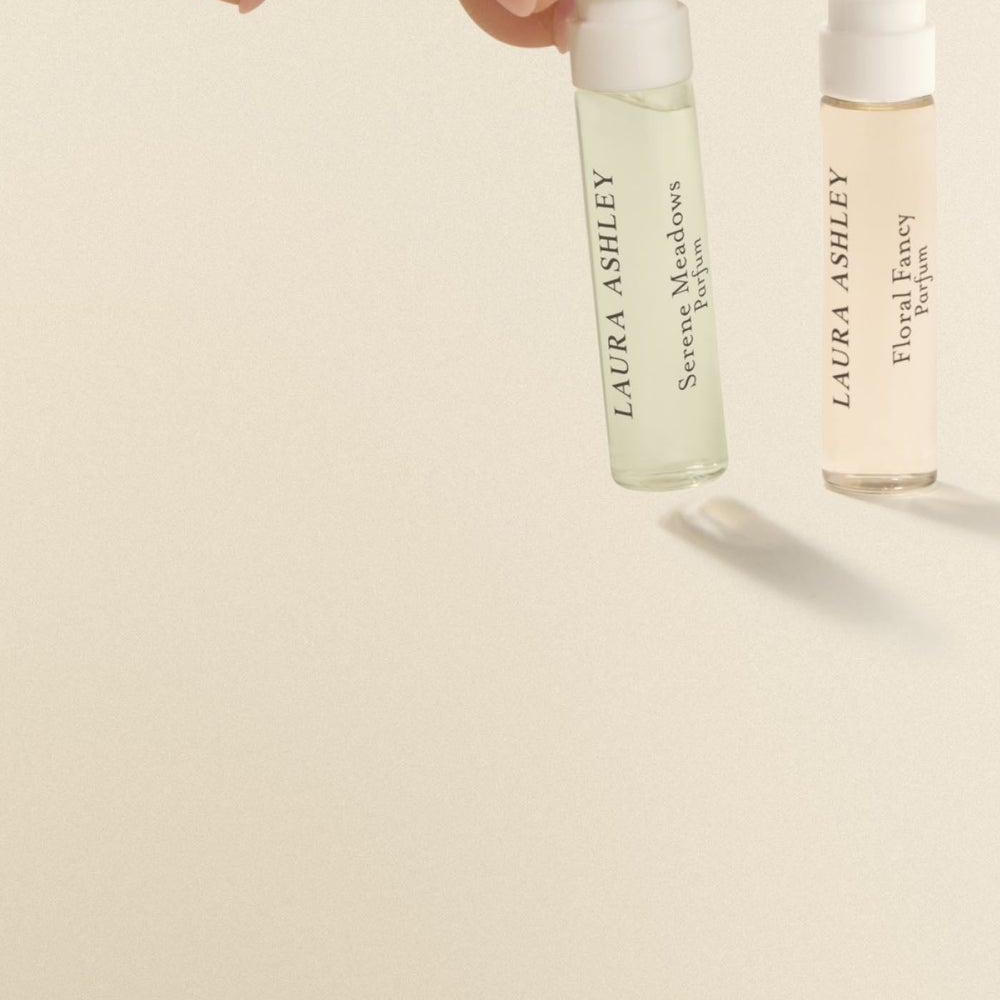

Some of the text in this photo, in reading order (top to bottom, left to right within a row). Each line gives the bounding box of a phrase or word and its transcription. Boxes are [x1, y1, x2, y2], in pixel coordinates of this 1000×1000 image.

[592, 168, 634, 419] LAURA ASHLEY
[666, 180, 697, 391] Serene Meadows
[691, 237, 709, 312] Parfum
[828, 167, 851, 409] LAURA ASHLEY
[891, 214, 916, 365] Floral Fancy
[913, 245, 934, 317] Parfum
